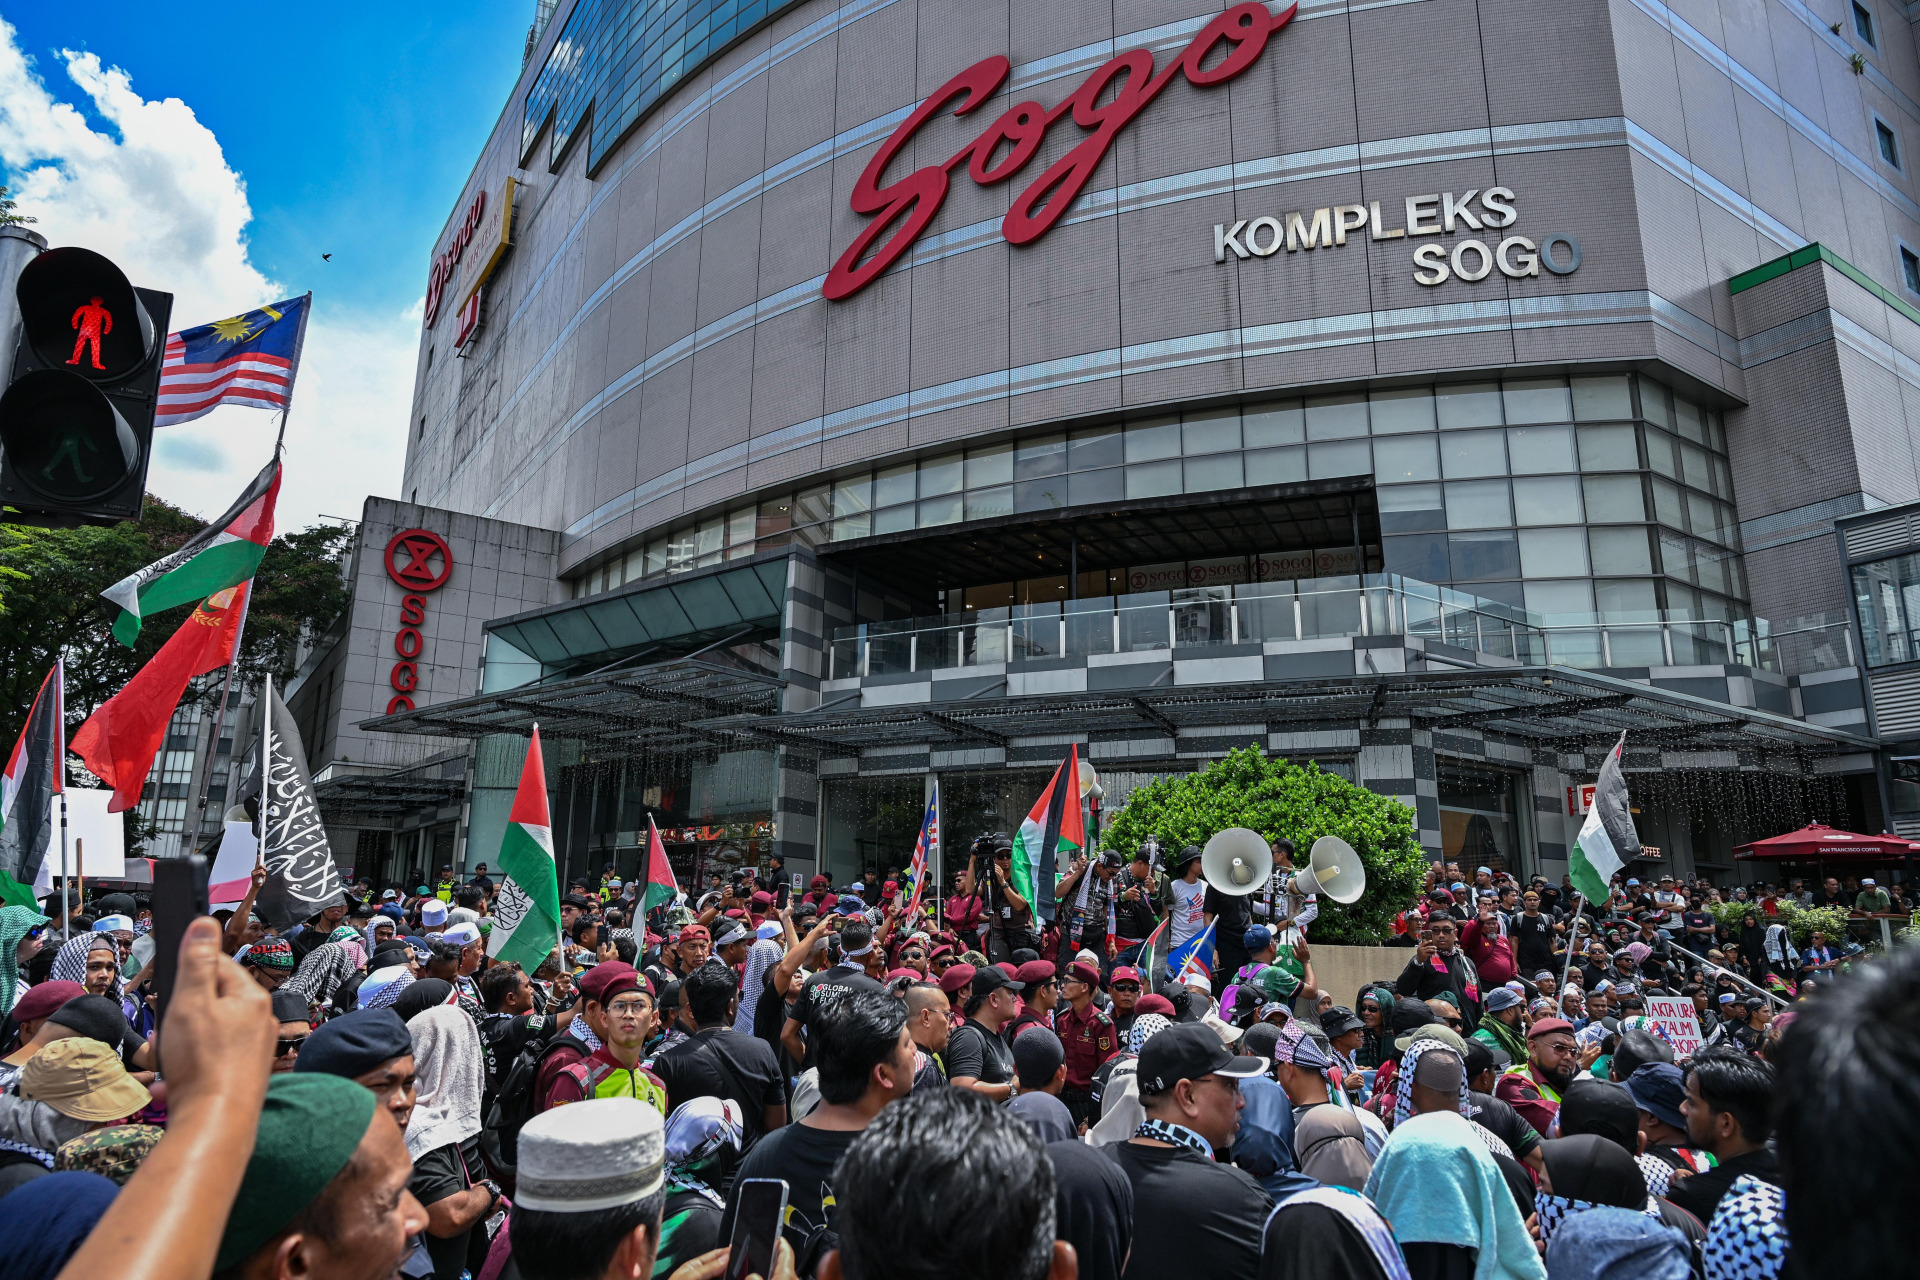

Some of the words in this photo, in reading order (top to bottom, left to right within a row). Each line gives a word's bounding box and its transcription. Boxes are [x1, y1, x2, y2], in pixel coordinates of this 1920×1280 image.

[1213, 186, 1518, 263] KOMPLEKS
[1413, 232, 1584, 286] SOGO
[1208, 563, 1247, 577] SOGO
[1272, 557, 1312, 571] SOGO
[1149, 570, 1186, 583] SOGO
[1640, 845, 1661, 857] OFFEE
[1651, 1002, 1677, 1018] AKTA
[1676, 1003, 1699, 1019] URA
[1673, 1038, 1700, 1054] AKYAT
